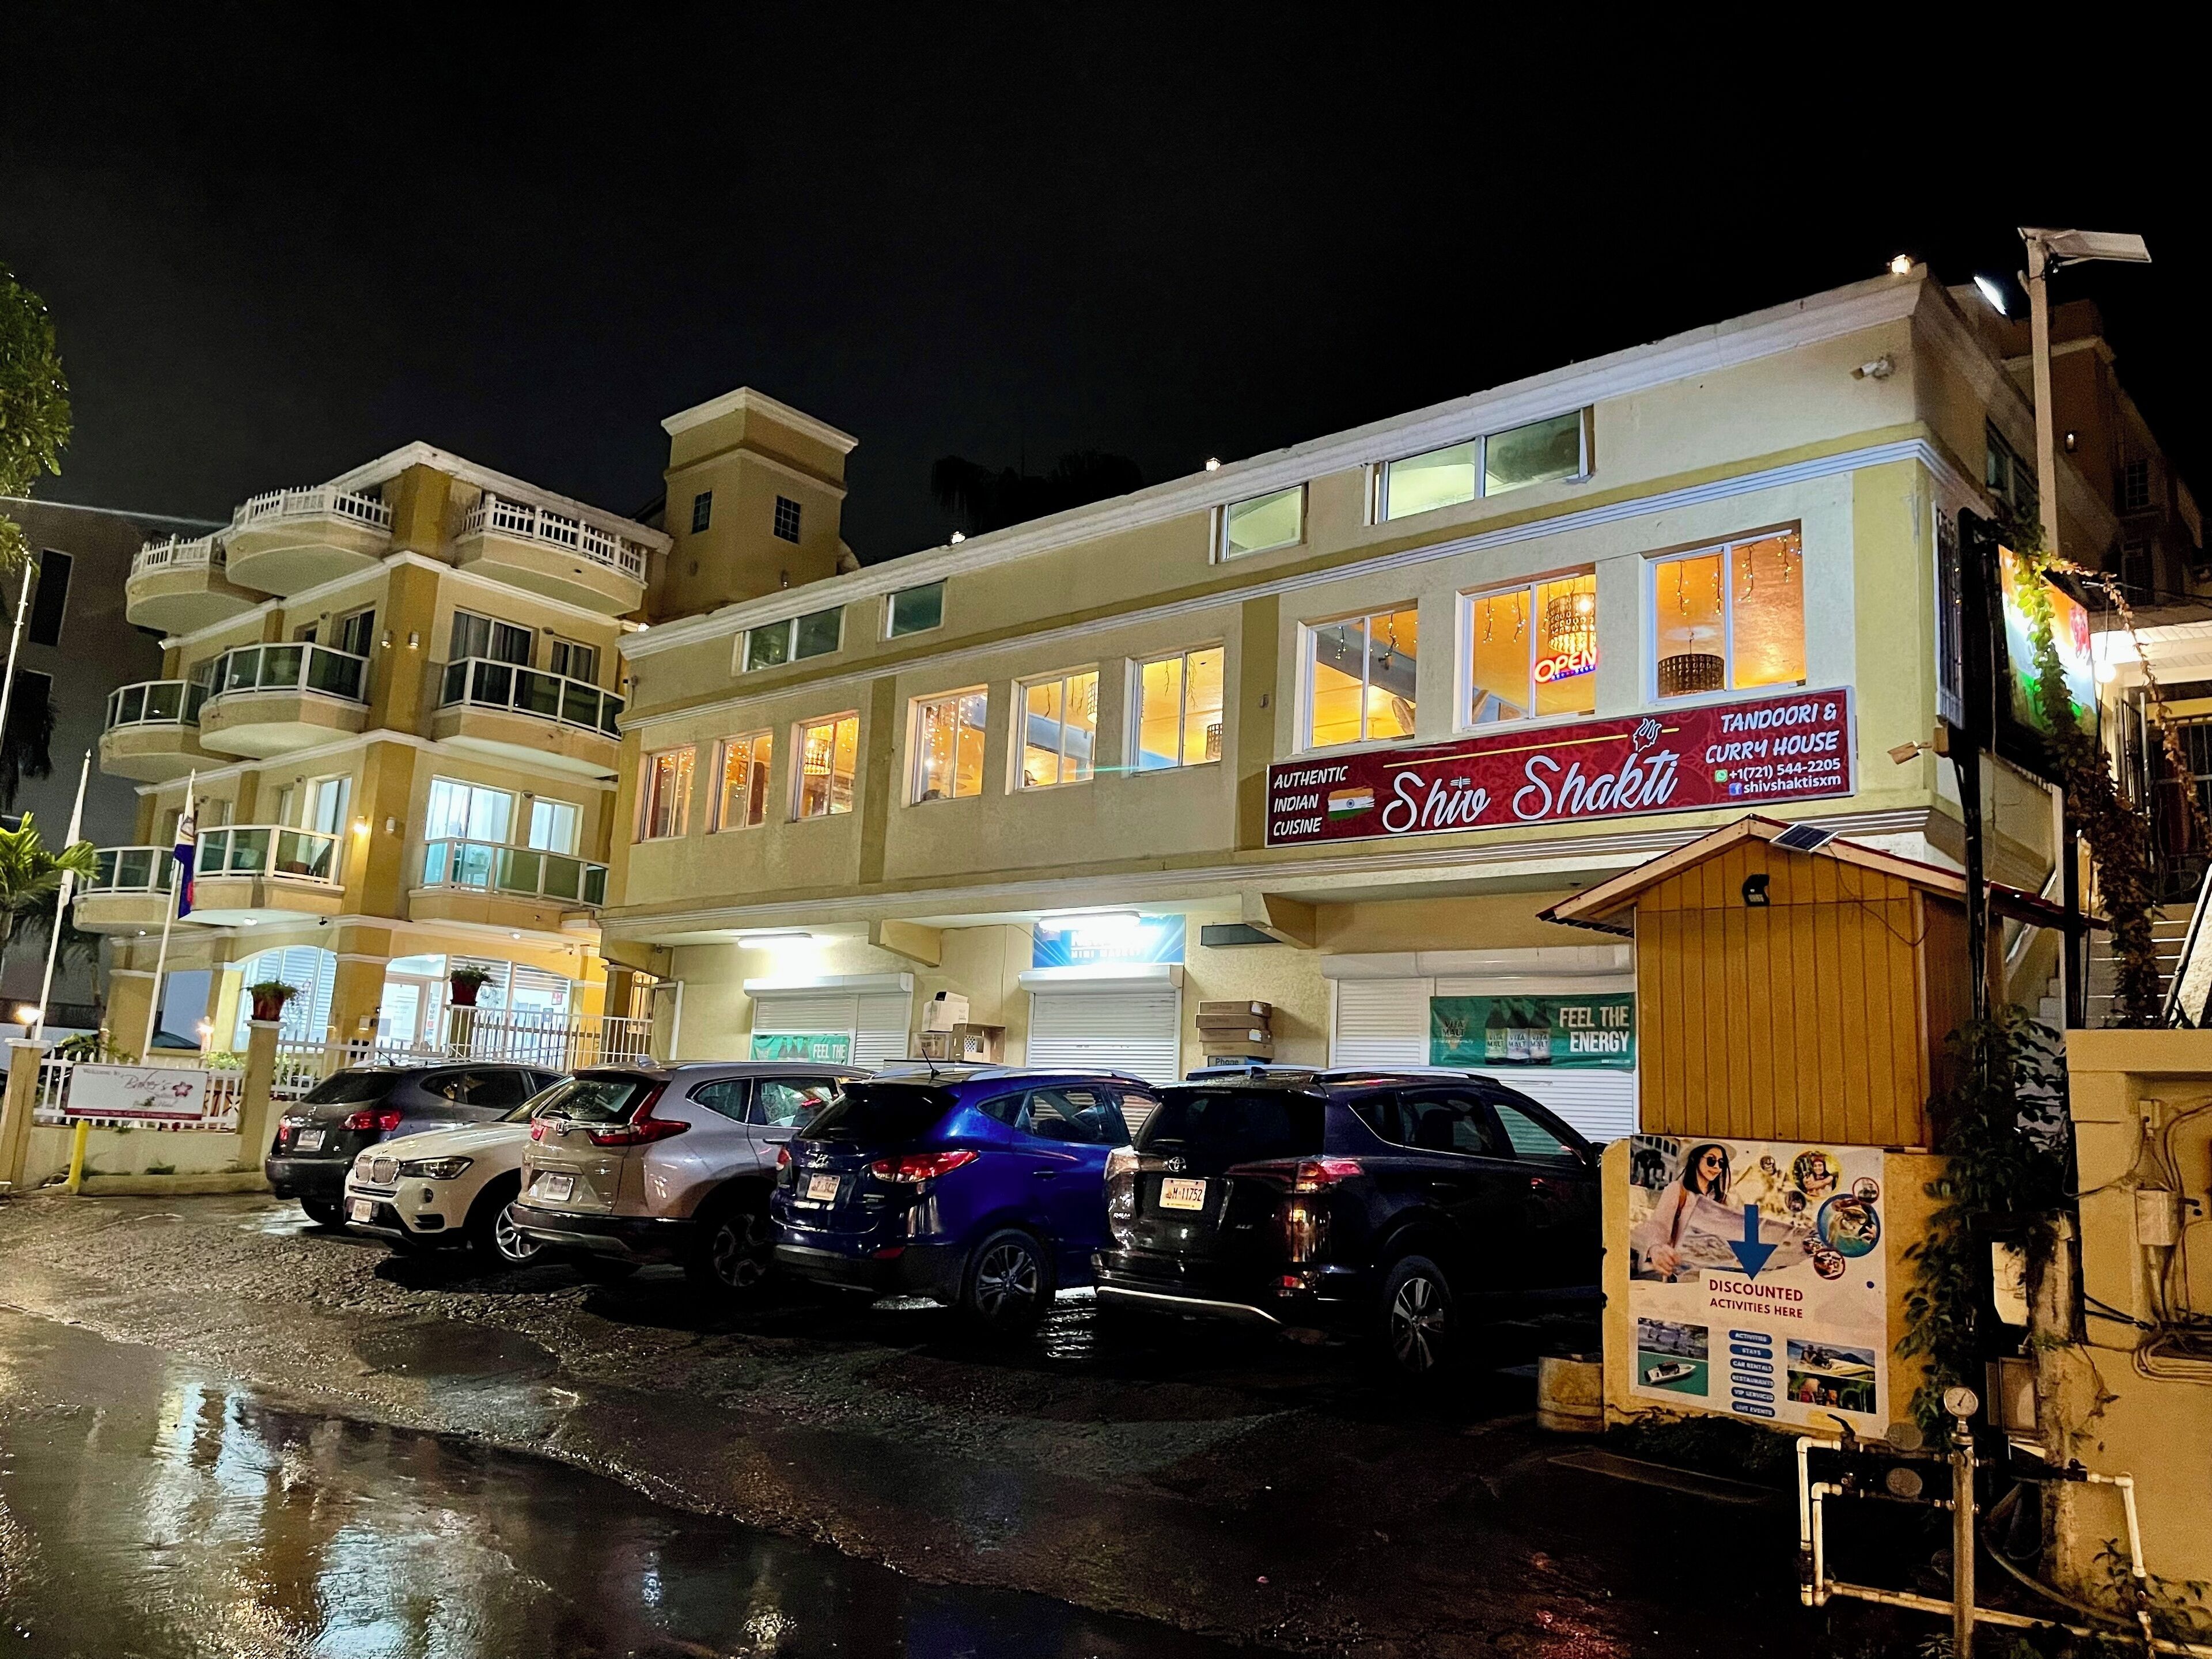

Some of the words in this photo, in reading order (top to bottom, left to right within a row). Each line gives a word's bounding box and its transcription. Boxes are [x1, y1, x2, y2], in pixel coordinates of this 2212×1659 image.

[1535, 646, 1597, 683] OPEN
[1721, 703, 1819, 733] TANDOORI
[1823, 703, 1837, 721] &
[1705, 738, 1768, 764] CURRY
[1773, 730, 1840, 756] HOUSE
[1274, 766, 1349, 789] AUTHENTIC
[1729, 764, 1774, 782] +1(721)
[1777, 757, 1840, 776] 544-2205
[1382, 771, 1491, 833] Shiv
[1513, 749, 1680, 820] Shakti
[1744, 775, 1841, 794] shivshaktisxm
[1274, 793, 1319, 813] INDIAN
[1273, 817, 1323, 836] CUISINE
[1444, 1020, 1464, 1028] VITA
[1559, 1007, 1595, 1028] FEEL
[1599, 1006, 1630, 1027] THE
[1442, 1028, 1465, 1036] MALT
[1570, 1031, 1630, 1052] ENERGY
[813, 1043, 830, 1059] FEEL
[832, 1044, 846, 1059] THE
[1709, 1279, 1803, 1301] DISCOUNTED
[1710, 1298, 1770, 1314] ACTIVITIES
[1774, 1305, 1803, 1319] HERE
[1735, 1332, 1767, 1342] ACTIVITIES
[1741, 1347, 1762, 1355] STAYS
[1746, 1362, 1772, 1371] RENTALS
